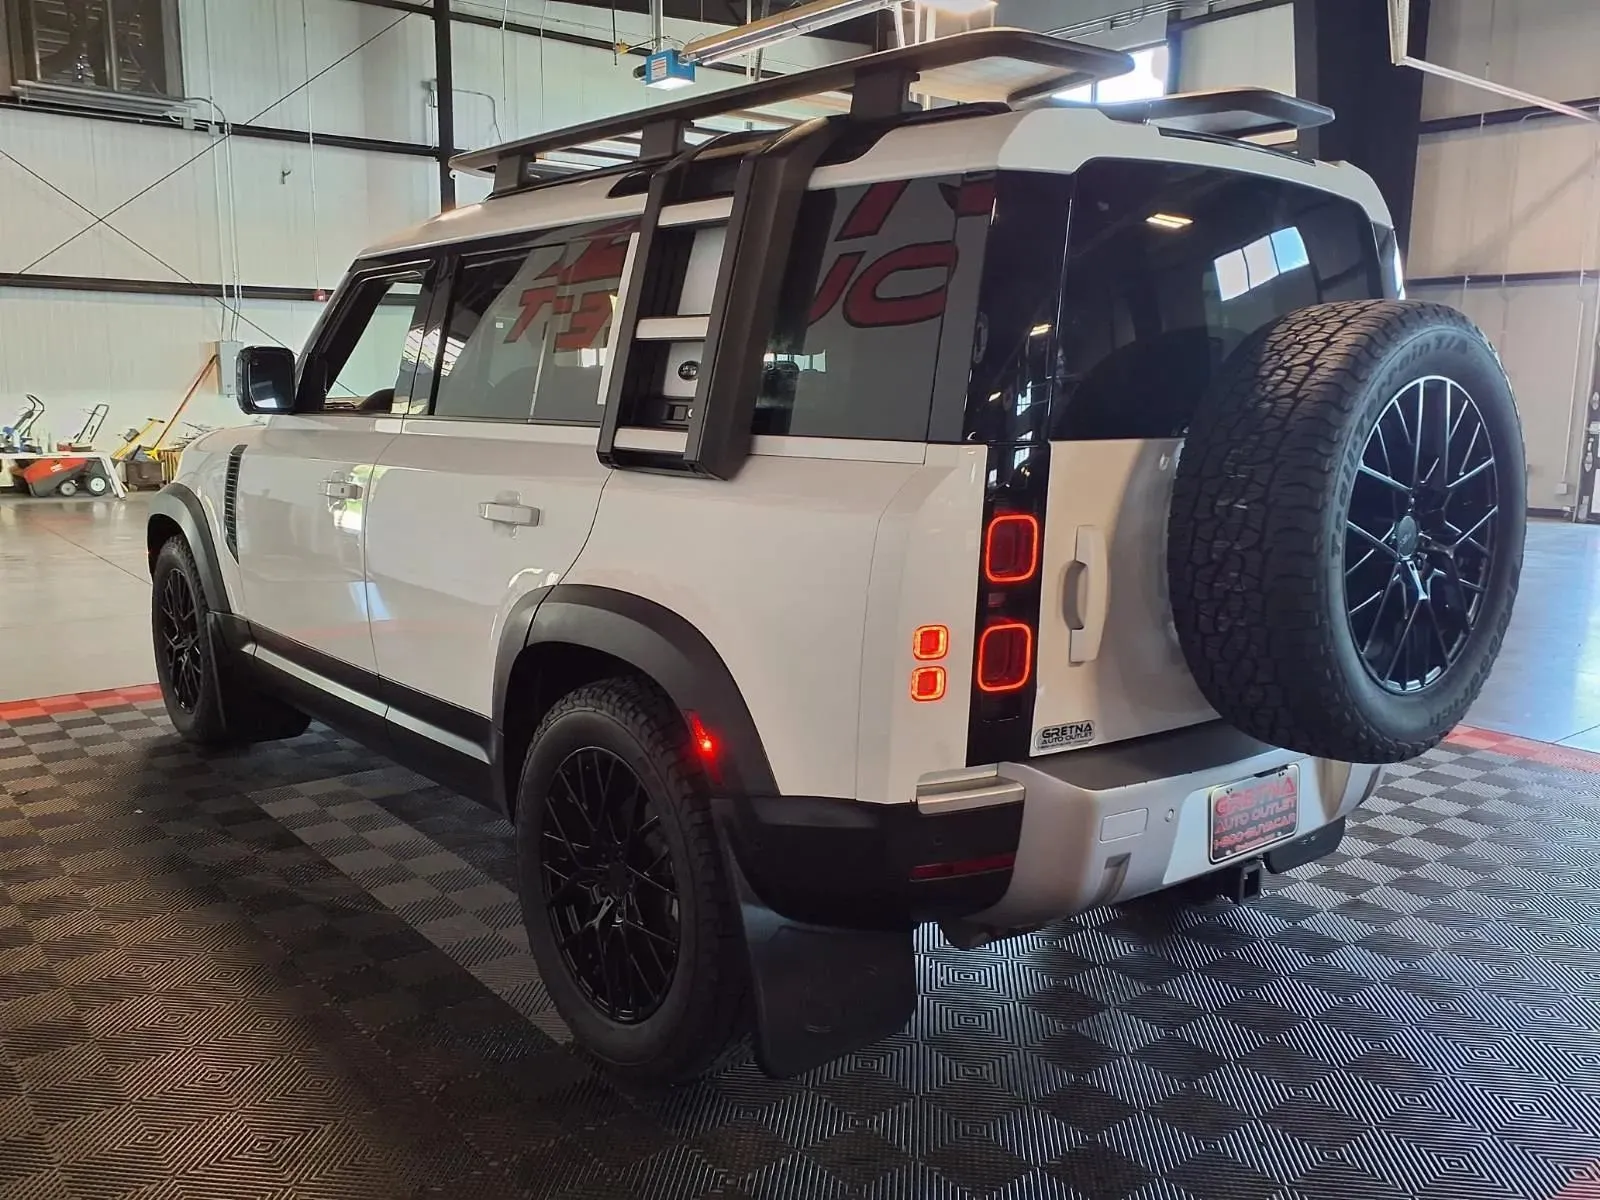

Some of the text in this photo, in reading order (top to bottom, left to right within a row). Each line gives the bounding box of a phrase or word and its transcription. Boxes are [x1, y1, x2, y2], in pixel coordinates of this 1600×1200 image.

[1042, 722, 1092, 739] GRETNA
[1042, 736, 1064, 745] AUTO
[1065, 732, 1092, 741] OUTLET
[1215, 777, 1296, 817] GRETNA
[1215, 796, 1295, 834] AUTO OUTLET
